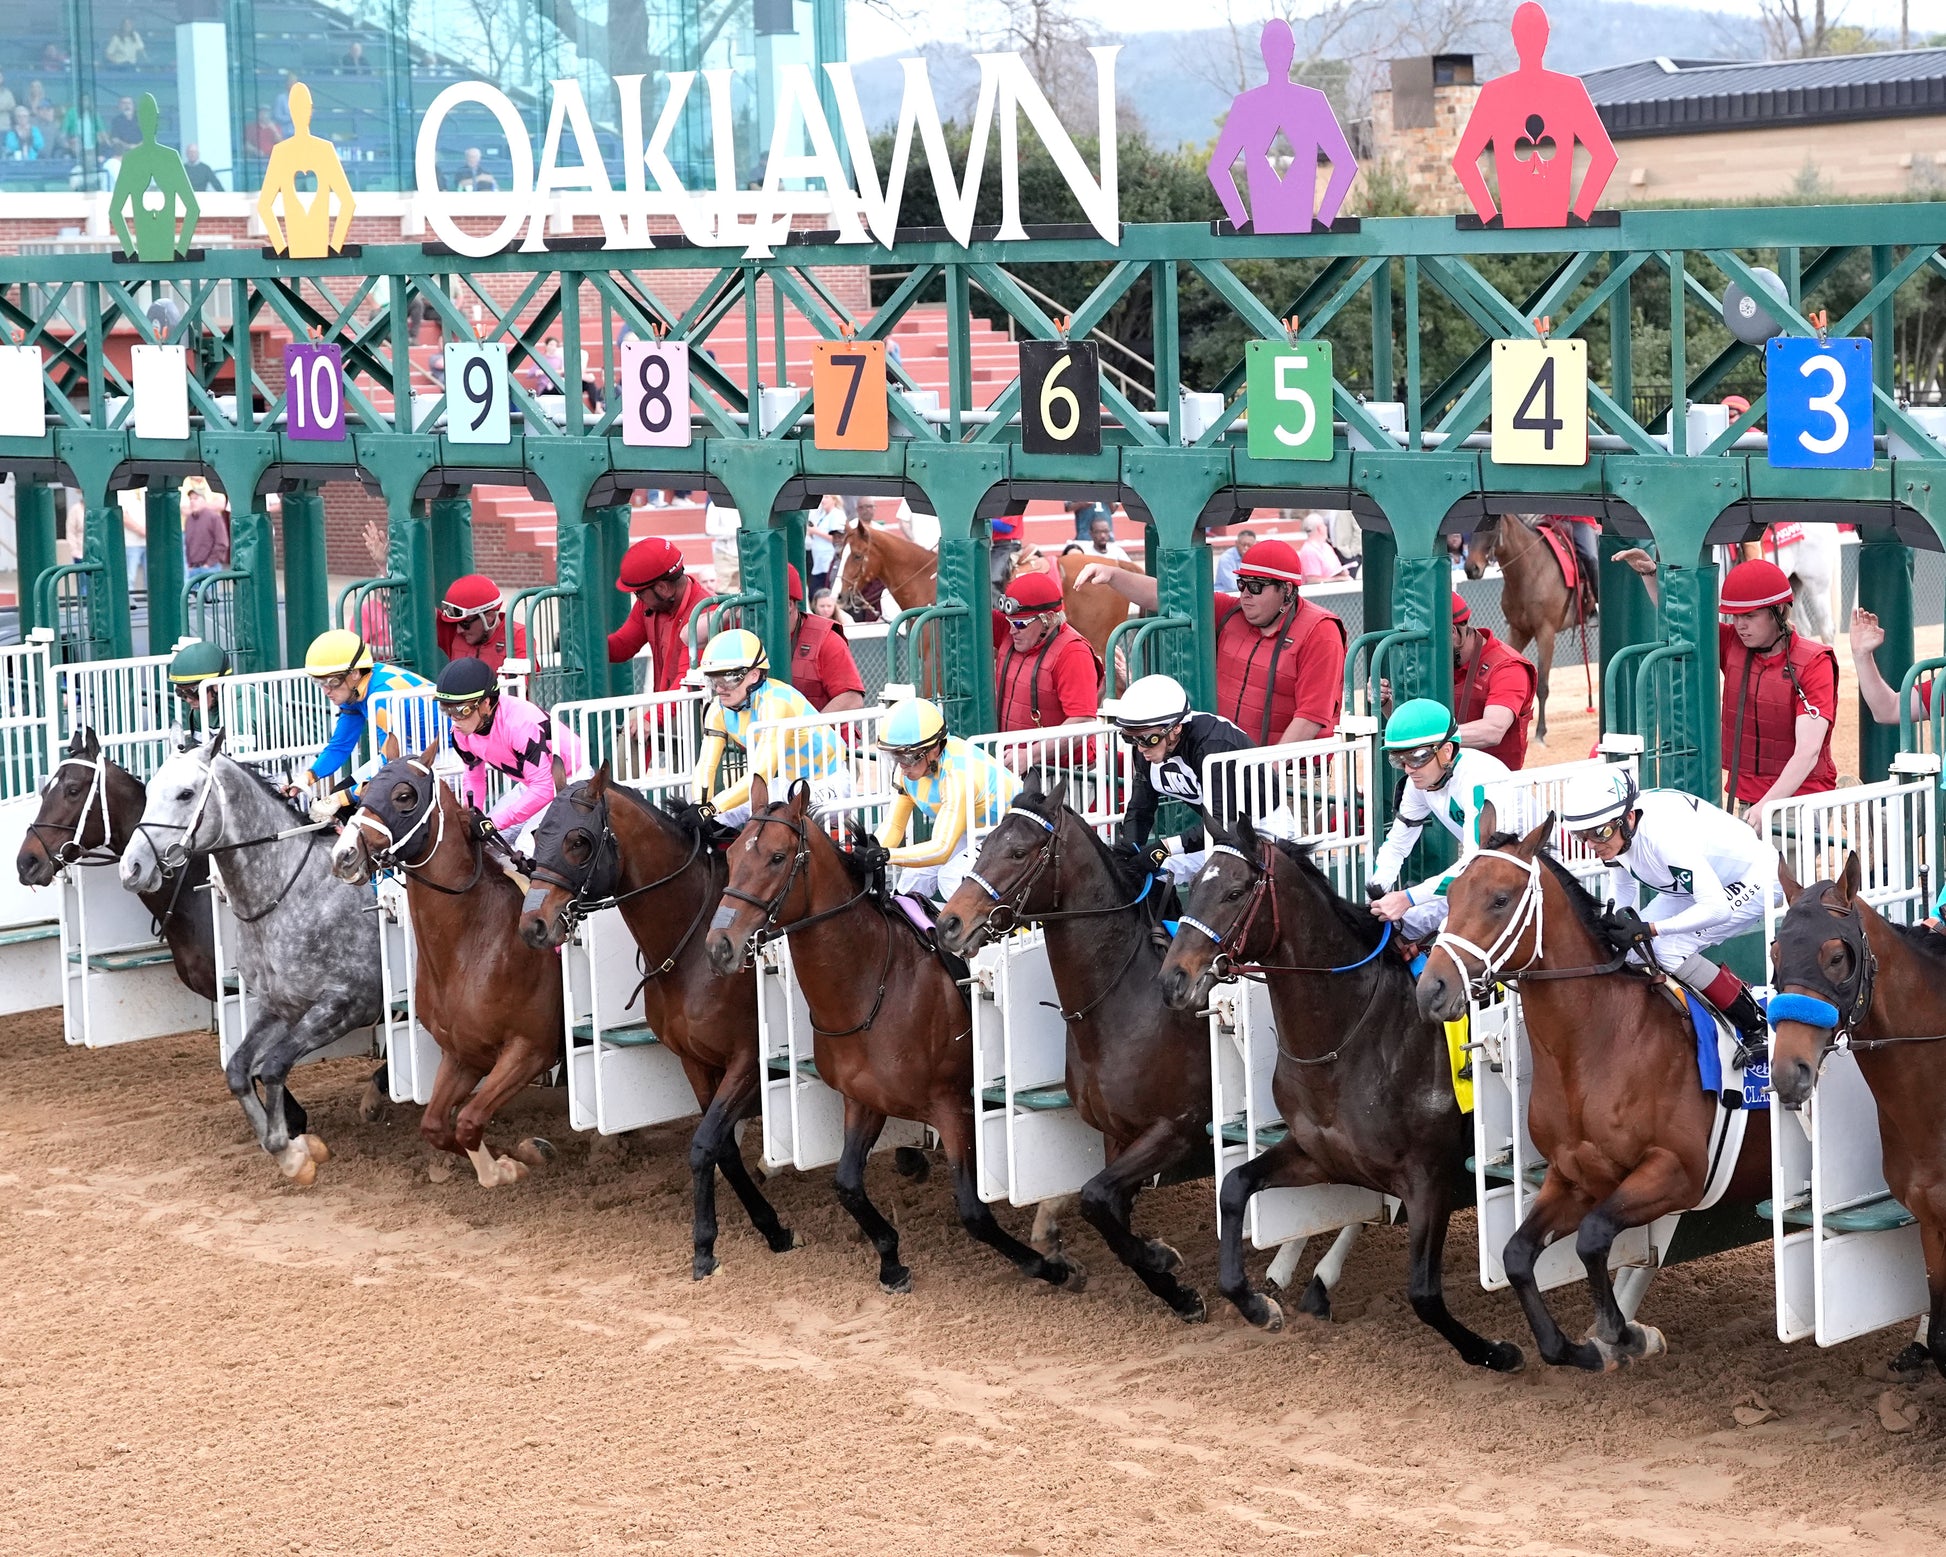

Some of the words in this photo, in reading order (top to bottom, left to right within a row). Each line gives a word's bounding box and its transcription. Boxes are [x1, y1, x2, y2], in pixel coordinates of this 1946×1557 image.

[415, 45, 1124, 259] OAKLAWN
[290, 355, 338, 430] 10
[463, 356, 494, 431] 9
[639, 354, 672, 433] 8
[830, 354, 867, 437] 7
[1039, 354, 1081, 441] 6
[1273, 356, 1316, 446] 5
[1512, 356, 1563, 450] 4
[1798, 354, 1849, 454] 3
